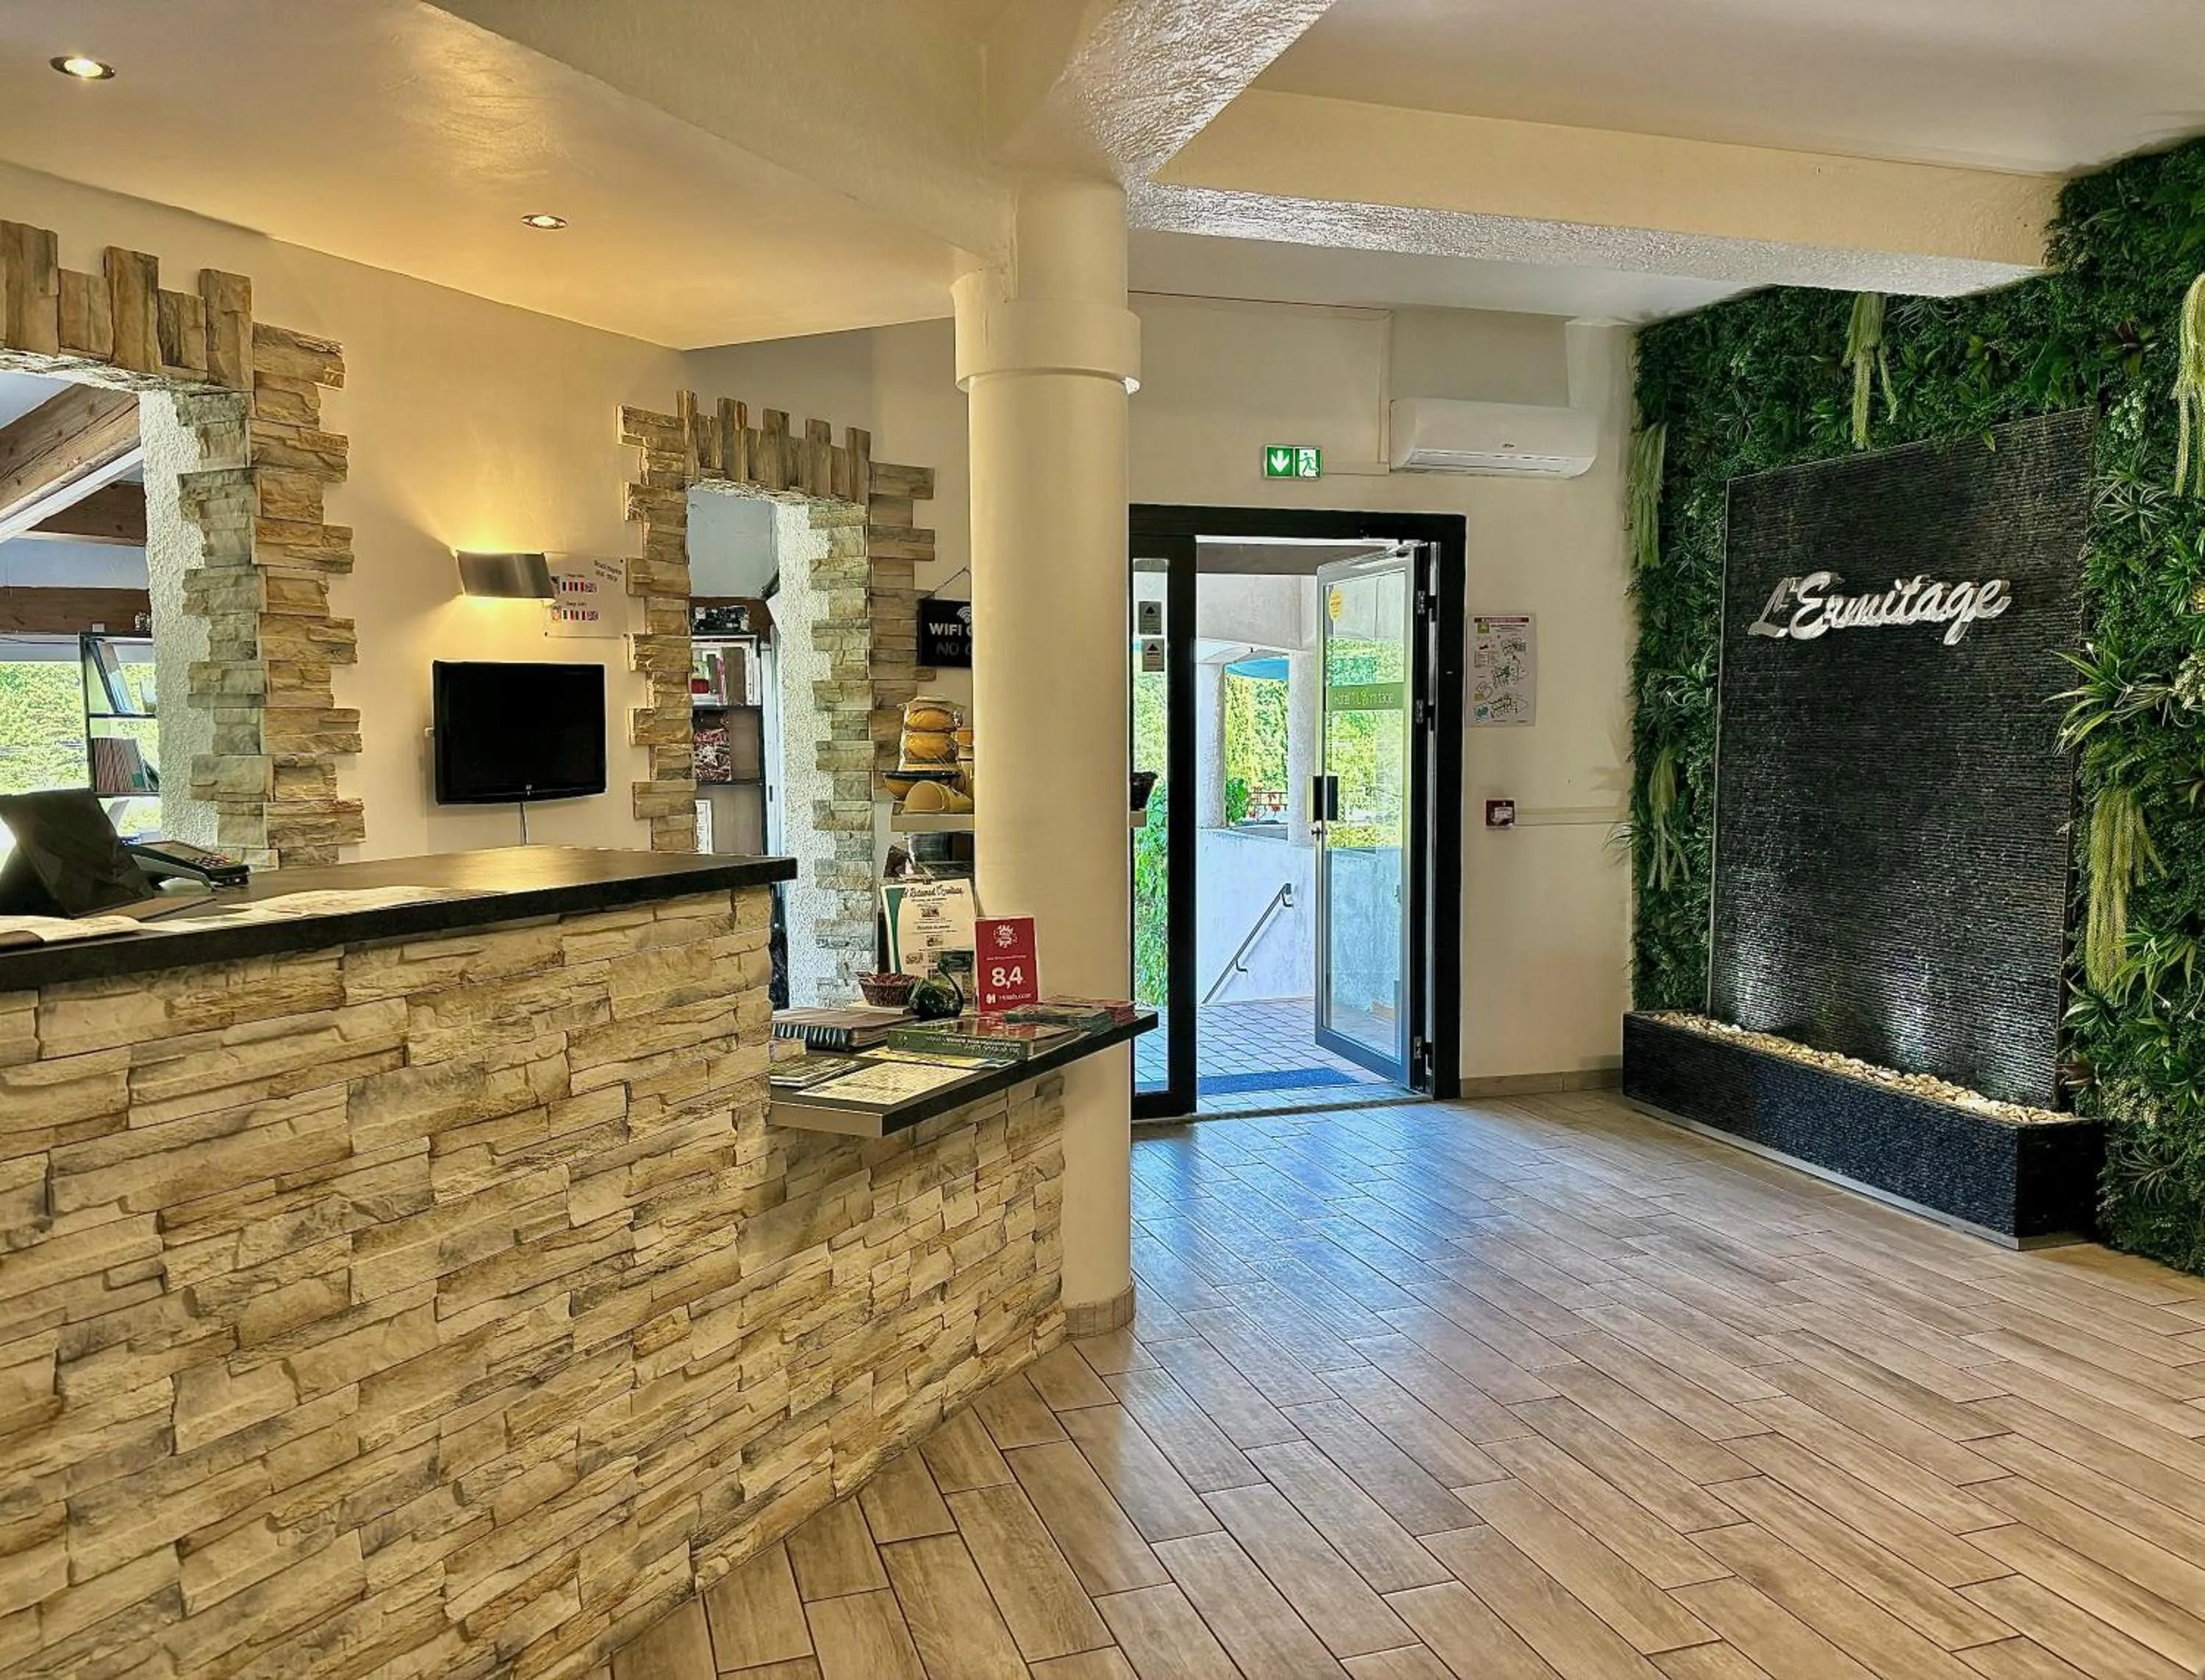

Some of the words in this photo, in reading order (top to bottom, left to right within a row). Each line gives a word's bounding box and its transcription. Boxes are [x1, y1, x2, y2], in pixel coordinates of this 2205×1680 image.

[1747, 571, 2012, 646] L'Ermitage
[929, 622, 962, 636] WIFI
[992, 966, 1024, 989] 8,4
